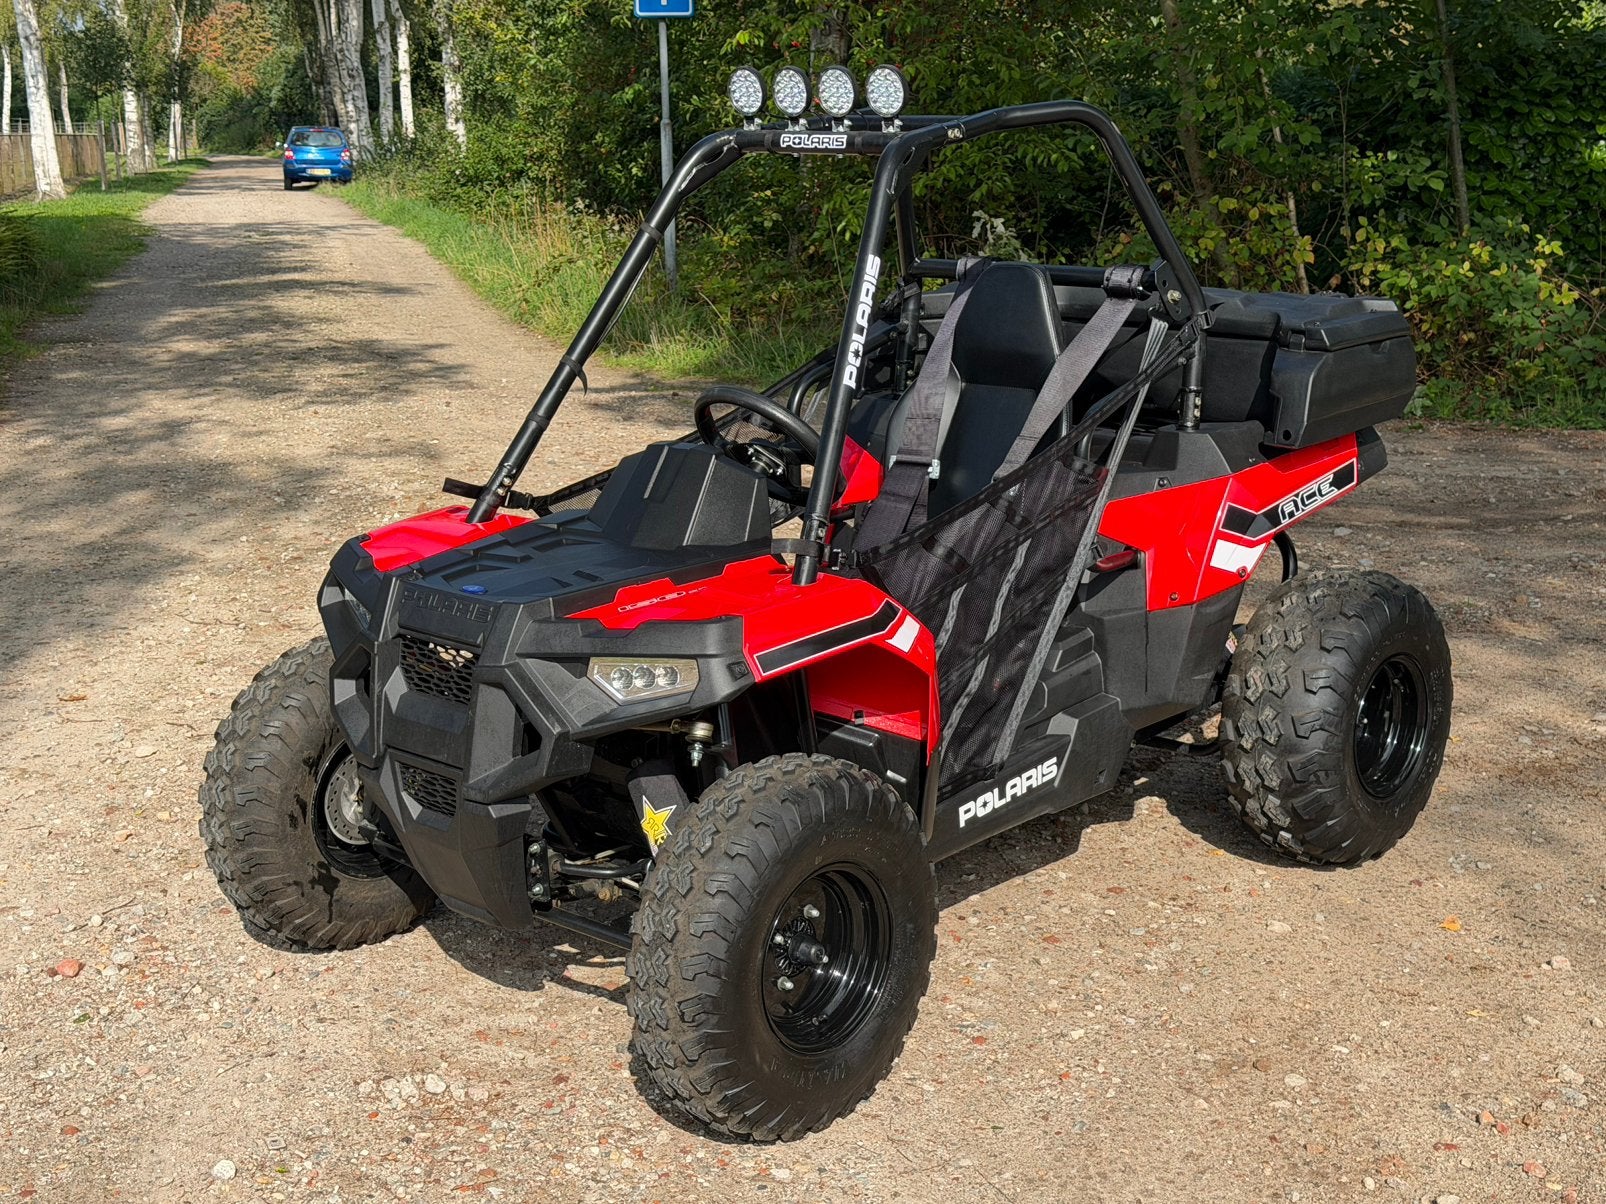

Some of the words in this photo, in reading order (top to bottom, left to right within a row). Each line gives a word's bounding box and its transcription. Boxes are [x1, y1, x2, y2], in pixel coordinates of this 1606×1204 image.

[780, 134, 847, 149] POLARIS
[843, 253, 881, 389] POLARIS
[1278, 474, 1338, 524] ACE
[958, 756, 1058, 828] POLARIS
